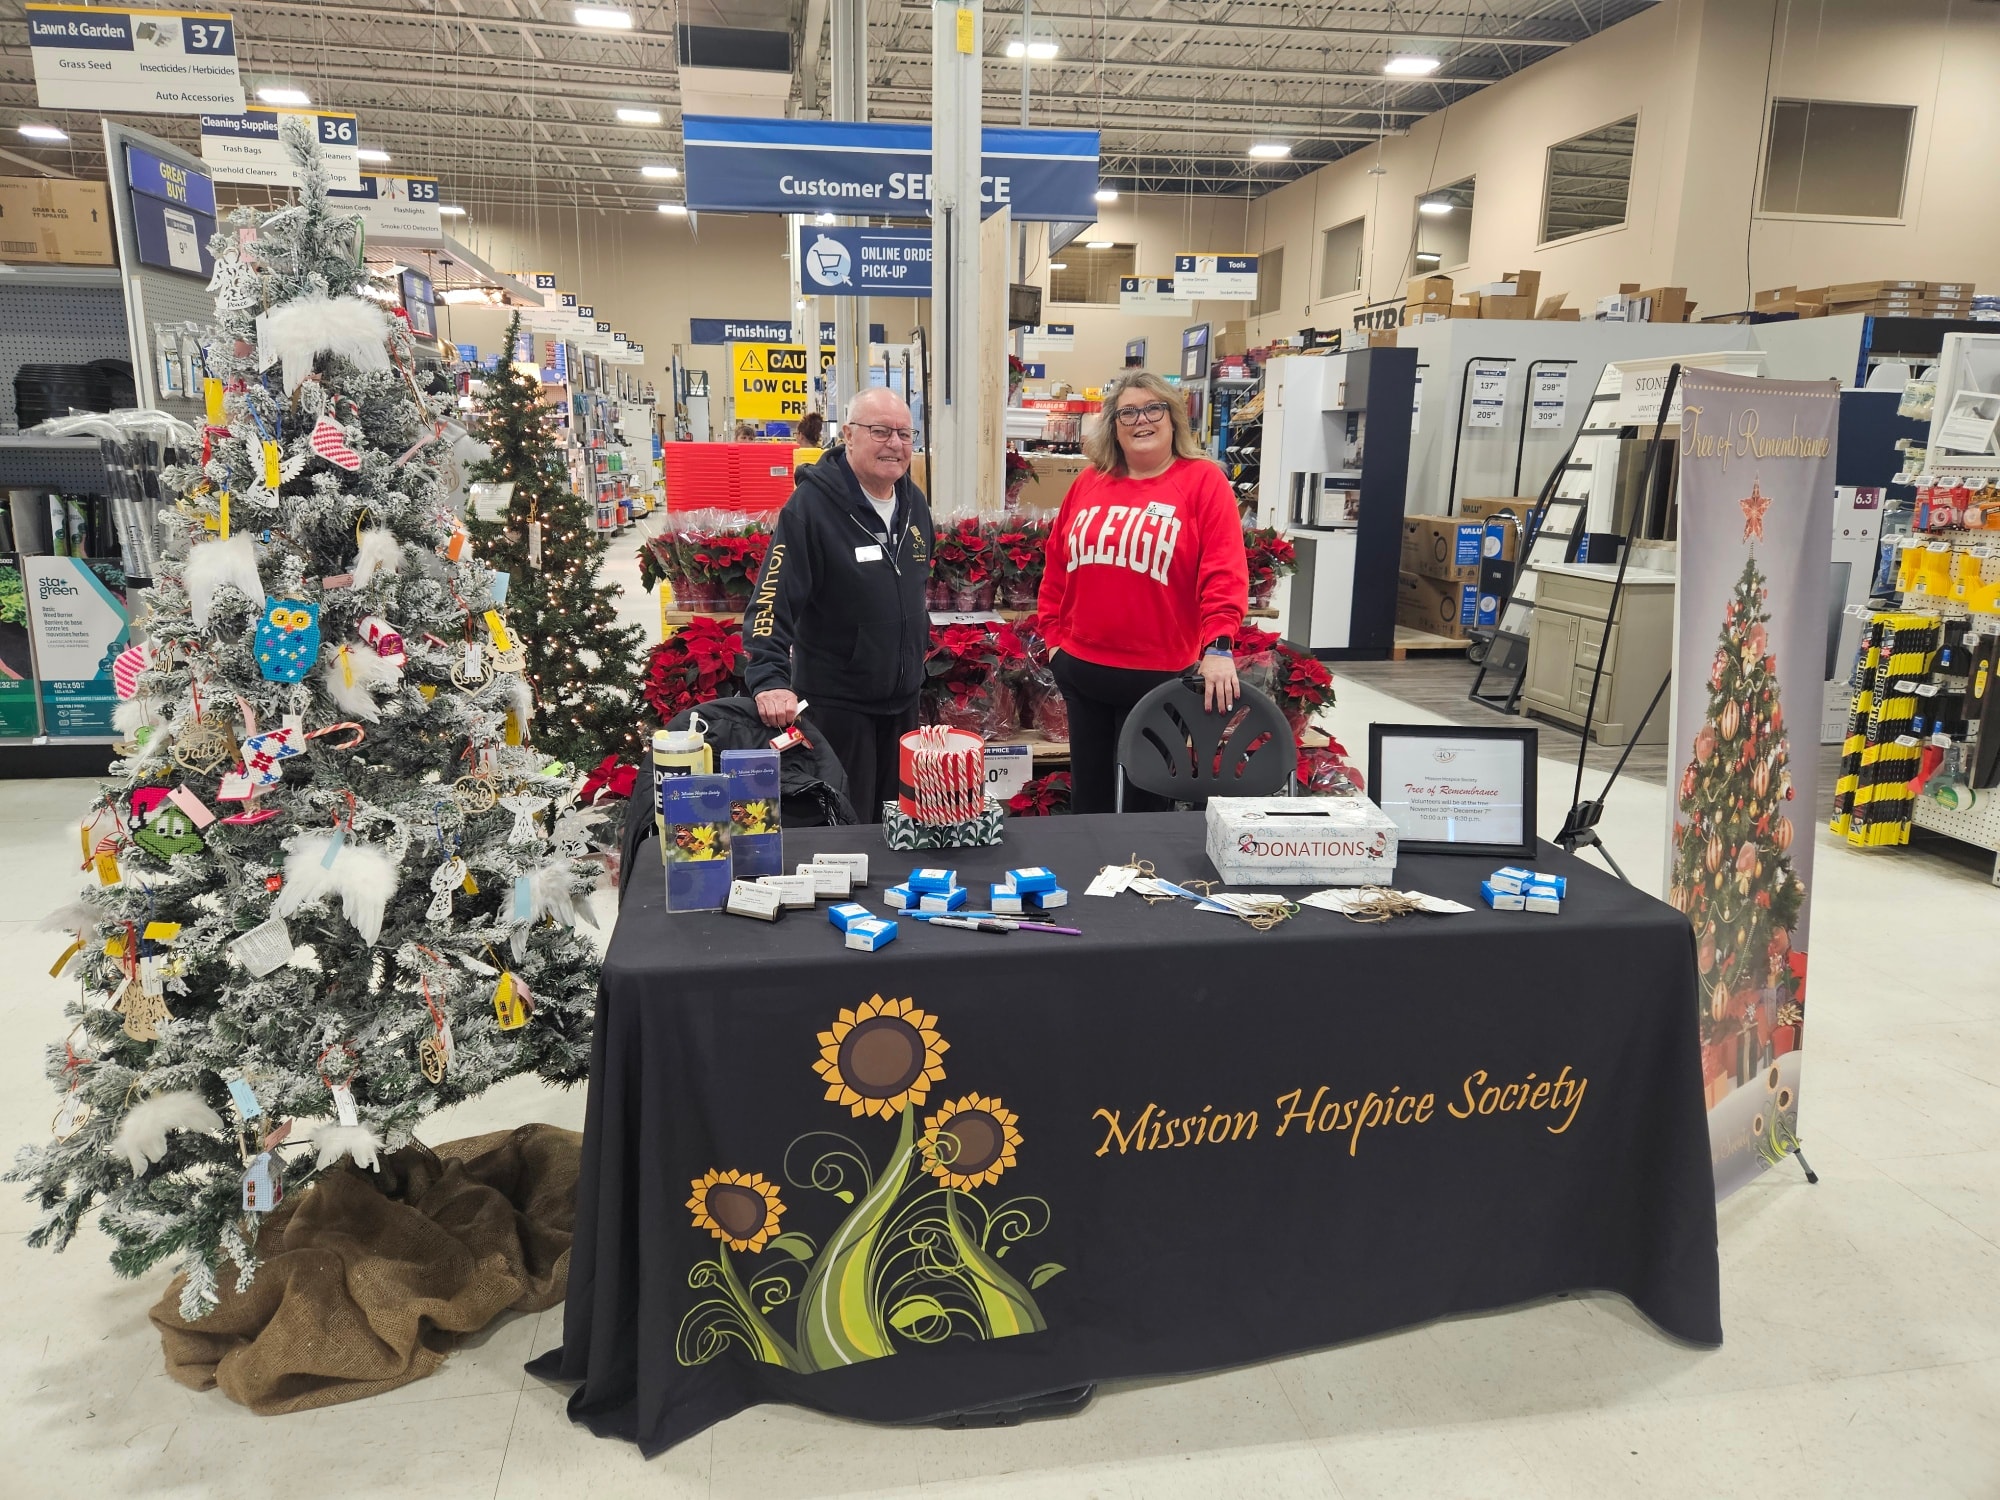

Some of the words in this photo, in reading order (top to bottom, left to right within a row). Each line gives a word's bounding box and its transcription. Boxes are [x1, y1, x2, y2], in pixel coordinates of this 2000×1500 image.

[32, 20, 67, 36] Lawn
[68, 22, 78, 36] &
[79, 23, 126, 39] Garden
[191, 24, 226, 49] 37
[59, 59, 86, 70] Grass
[87, 60, 112, 70] Seed
[140, 63, 187, 74] Insecticides
[192, 65, 235, 76] Herbicides
[155, 91, 179, 101] Auto
[181, 92, 235, 103] Accessories
[201, 116, 241, 132] Cleaning
[242, 118, 279, 133] Supplies
[324, 121, 352, 141] 36
[222, 145, 242, 154] Trash
[243, 146, 262, 156] Bags
[325, 151, 352, 161] leaners
[159, 161, 187, 187] GREAT
[245, 168, 278, 177] Cleaners
[166, 182, 187, 202] BUY!
[412, 184, 435, 199] 35
[779, 174, 884, 198] Customer
[354, 203, 371, 211] Cords
[393, 206, 425, 215] Flashlights
[381, 223, 400, 231] Smoke
[861, 246, 900, 261] ONLINE
[904, 247, 932, 262] ORDE
[1182, 258, 1190, 270] 5
[1228, 261, 1247, 269] Tools
[861, 264, 908, 279] PICK-UP
[538, 276, 553, 287] 32
[1126, 280, 1134, 290] 6
[562, 296, 573, 305] 31
[580, 307, 592, 316] 30
[598, 323, 609, 331] 29
[725, 324, 787, 341] Finishing
[615, 333, 625, 341] 28
[743, 379, 778, 393] LOW
[1635, 376, 1668, 391] STONE
[1681, 406, 1714, 456] Tree
[1717, 410, 1733, 472] of
[1737, 408, 1831, 458] Remembrance
[1855, 493, 1873, 505] 6.3
[1066, 505, 1182, 587] SLEIGH
[38, 576, 60, 587] sta
[40, 585, 79, 600] green
[752, 544, 786, 638] VOLUNTEER
[1866, 663, 1888, 741] GRIPSTRIP
[985, 768, 1009, 783] 079
[1404, 783, 1424, 794] Tree
[1426, 785, 1436, 796] of
[1439, 785, 1499, 796] Remembrance
[1257, 841, 1365, 857] DONATIONS
[1092, 1103, 1259, 1158] Mission
[1275, 1085, 1435, 1157] Hospice
[1447, 1066, 1588, 1134] Society
